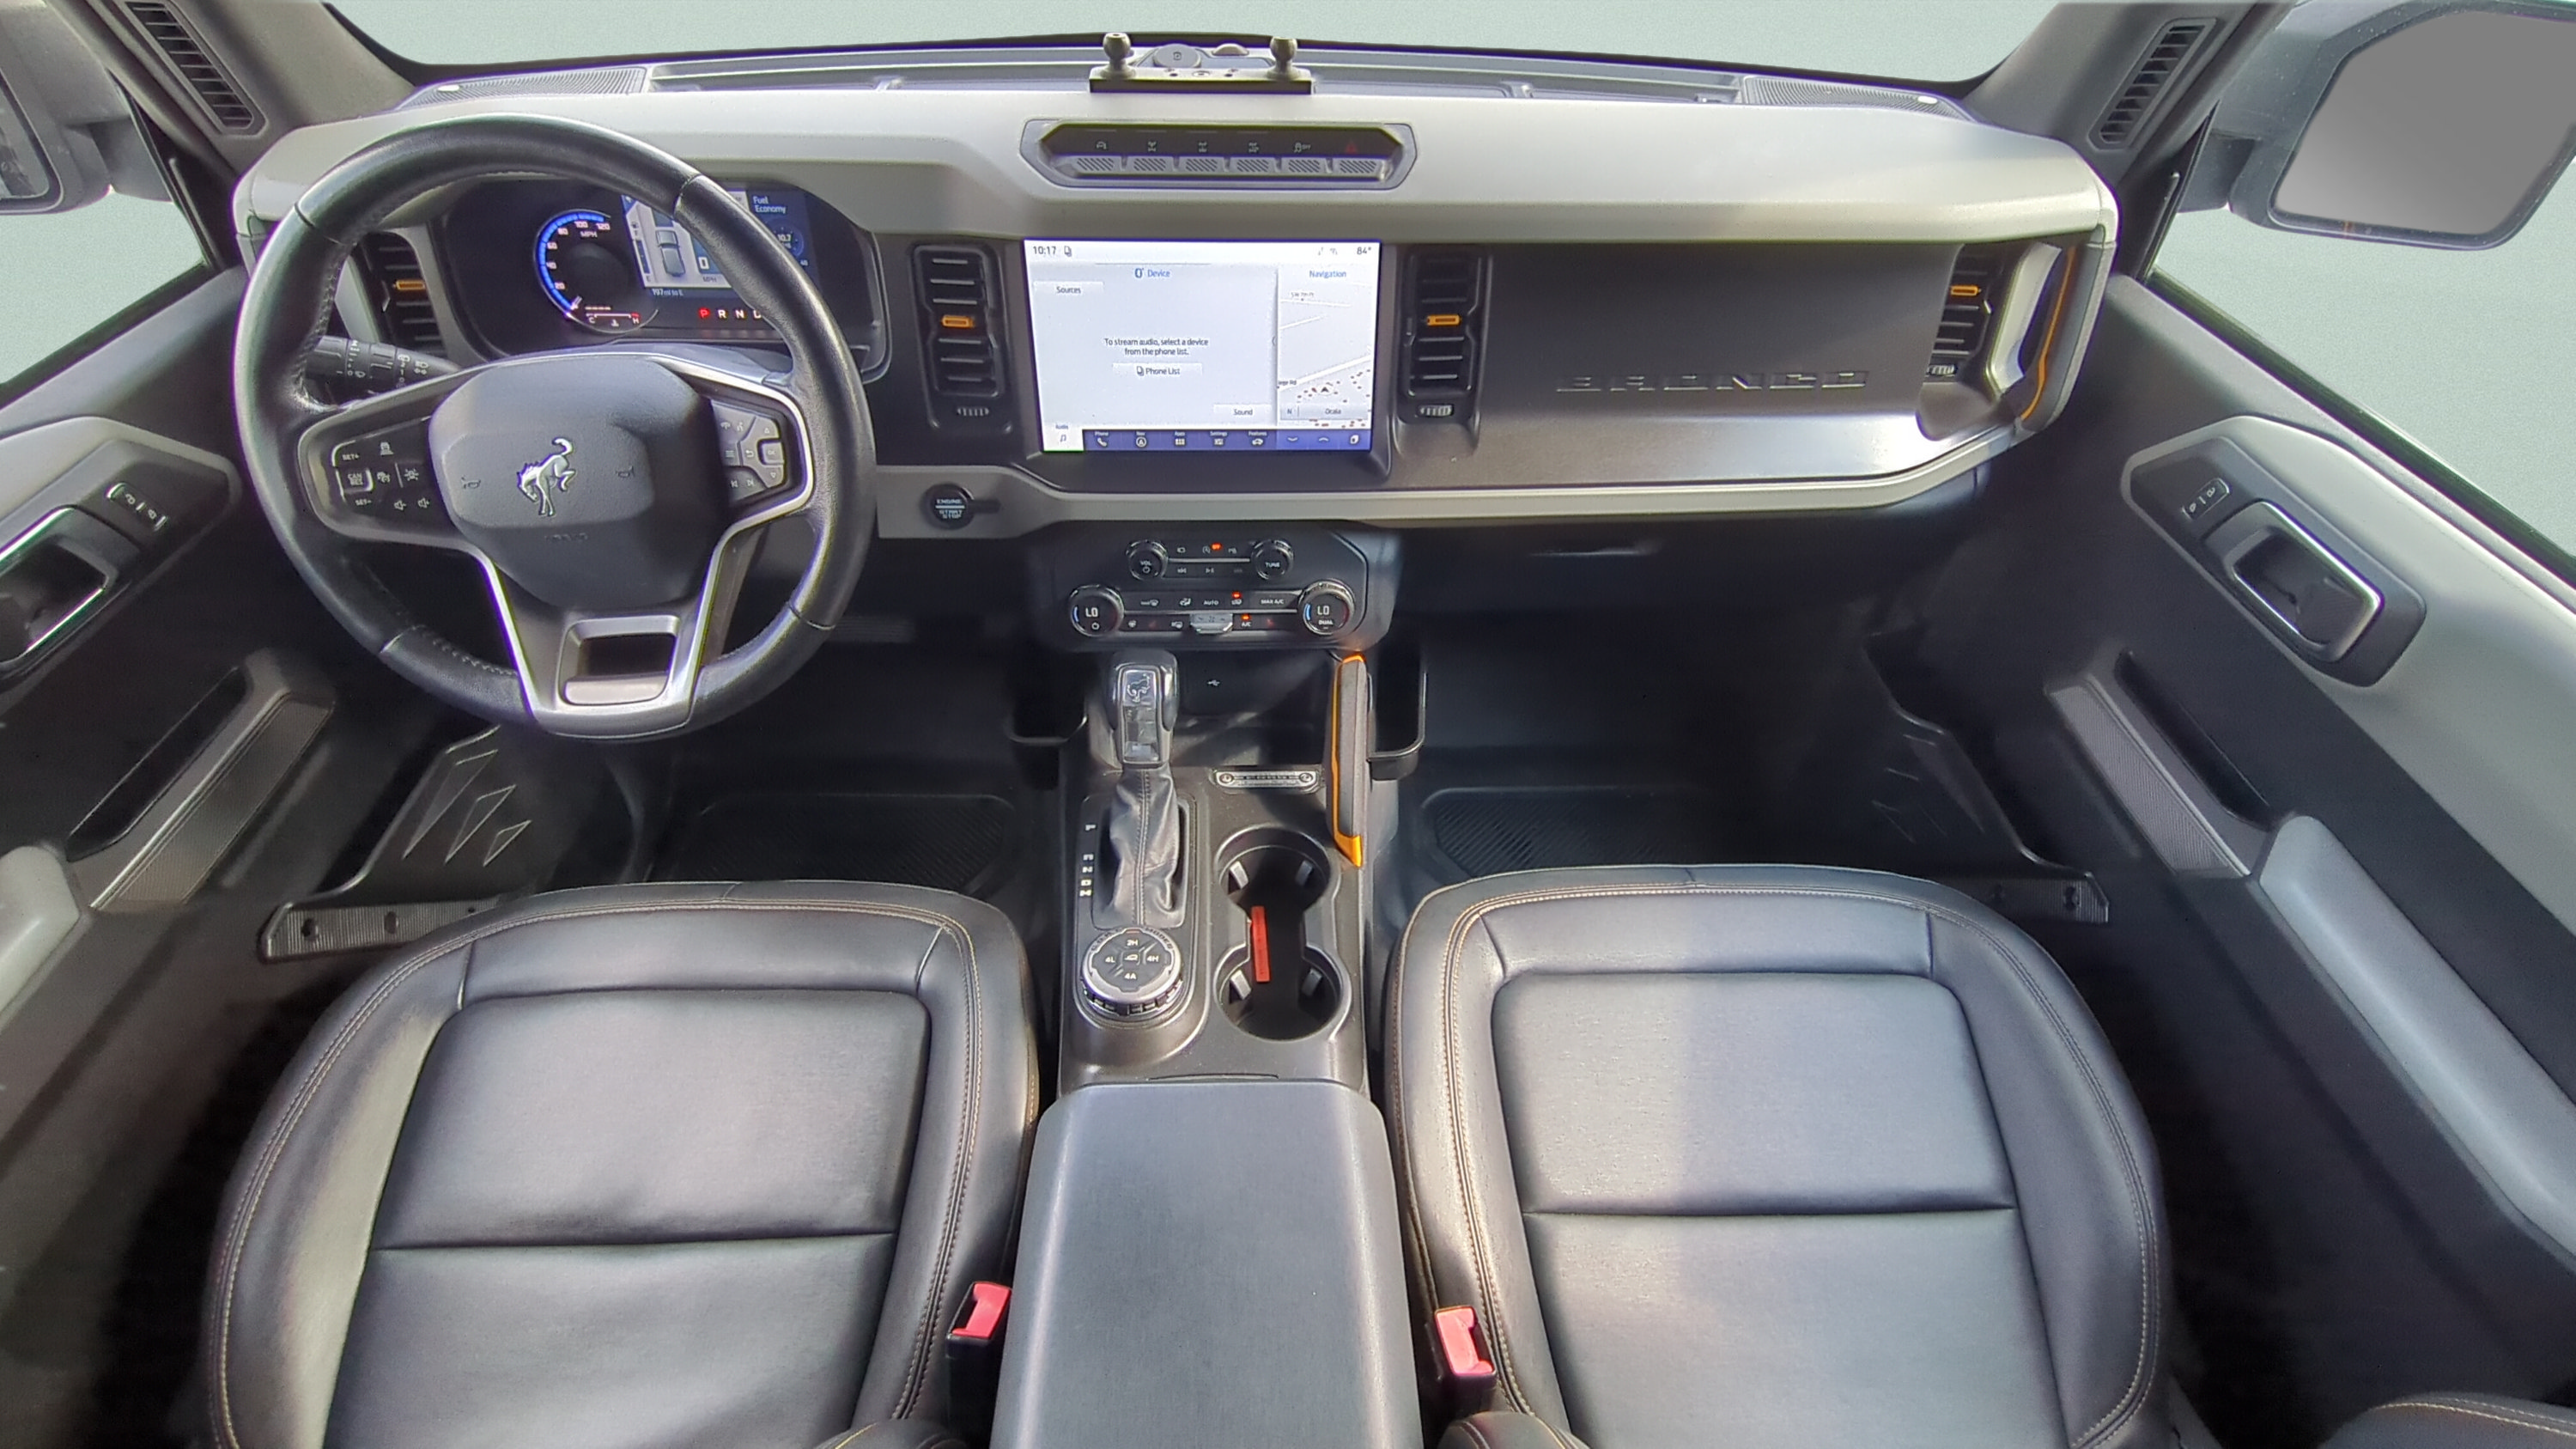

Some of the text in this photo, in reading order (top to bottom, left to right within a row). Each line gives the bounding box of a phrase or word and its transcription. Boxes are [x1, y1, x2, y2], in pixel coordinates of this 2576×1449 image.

[753, 196, 769, 204] Fuel
[755, 205, 787, 214] Economy
[1033, 246, 1057, 255] 10:17
[1147, 269, 1170, 278] Device
[1309, 270, 1347, 279] Navigation
[699, 309, 709, 318] P
[718, 310, 726, 318] R
[735, 310, 745, 318] N
[1154, 348, 1176, 356] phone
[1557, 370, 1870, 392] BRONCO
[1085, 607, 1098, 617] LO
[1317, 606, 1330, 615] LO
